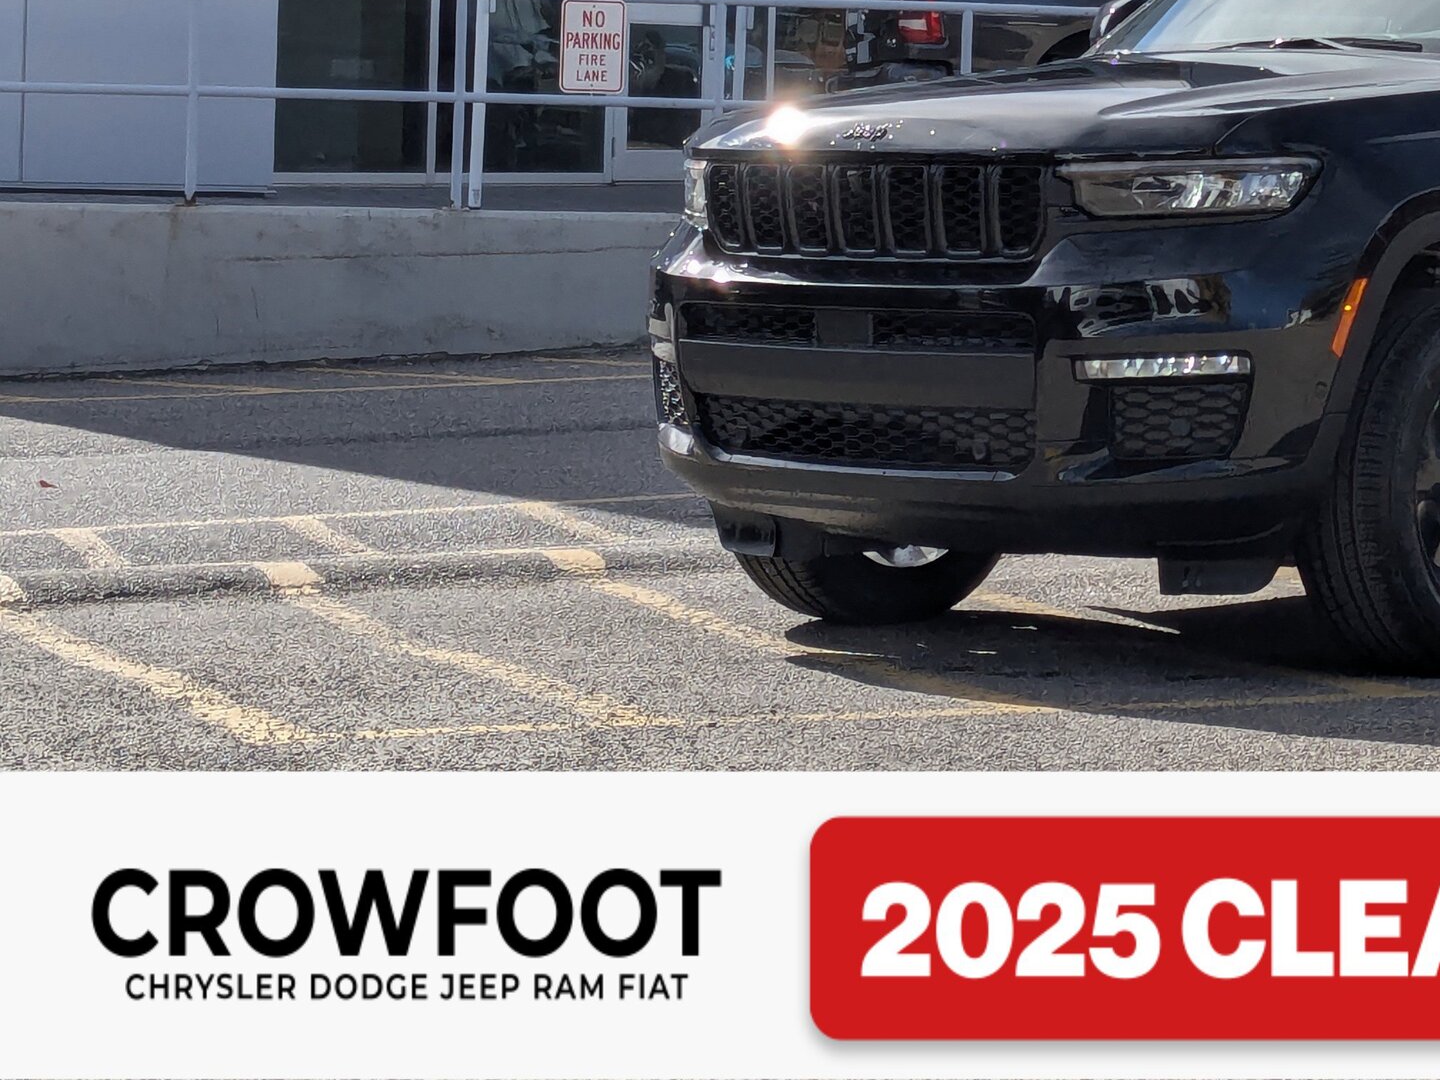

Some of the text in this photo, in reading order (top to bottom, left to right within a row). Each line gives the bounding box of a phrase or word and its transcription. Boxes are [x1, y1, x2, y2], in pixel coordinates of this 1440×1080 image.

[582, 10, 606, 28] NO
[566, 32, 621, 51] PARKING
[578, 54, 607, 66] FIRE
[576, 70, 608, 82] LANE
